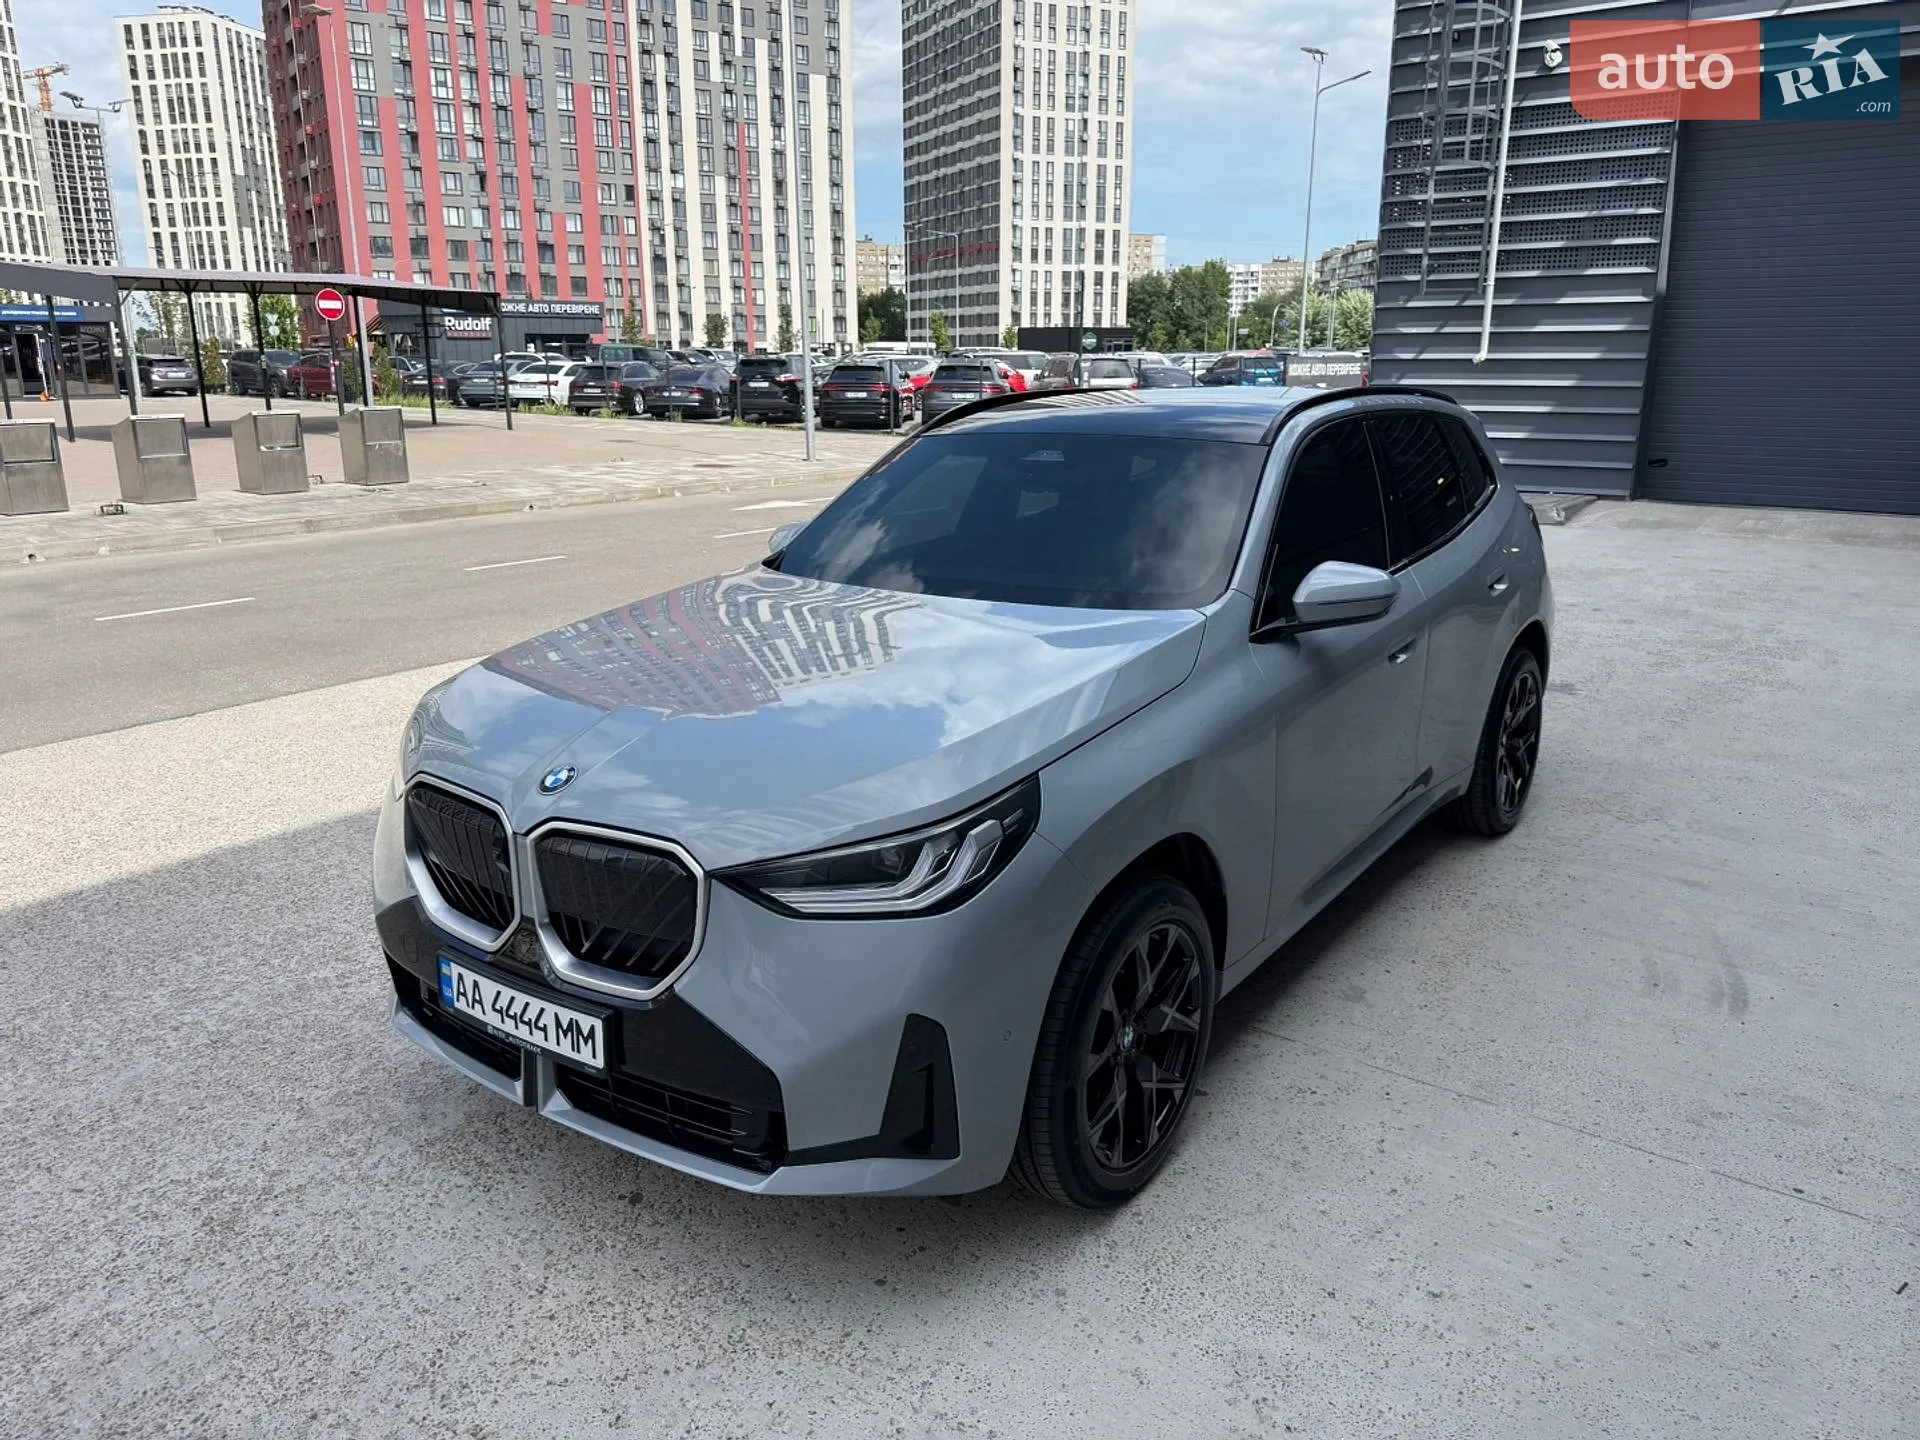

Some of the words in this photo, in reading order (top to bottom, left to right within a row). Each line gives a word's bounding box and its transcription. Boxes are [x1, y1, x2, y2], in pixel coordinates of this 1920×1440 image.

[501, 303, 526, 313] ОЖНЕ
[528, 304, 549, 313] АВТО
[551, 304, 600, 314] ПЕРЕВІРЕНЕ
[444, 316, 492, 331] Rudolf
[456, 971, 486, 1016] AA
[491, 990, 548, 1042] 4444
[554, 1011, 597, 1060] MM
